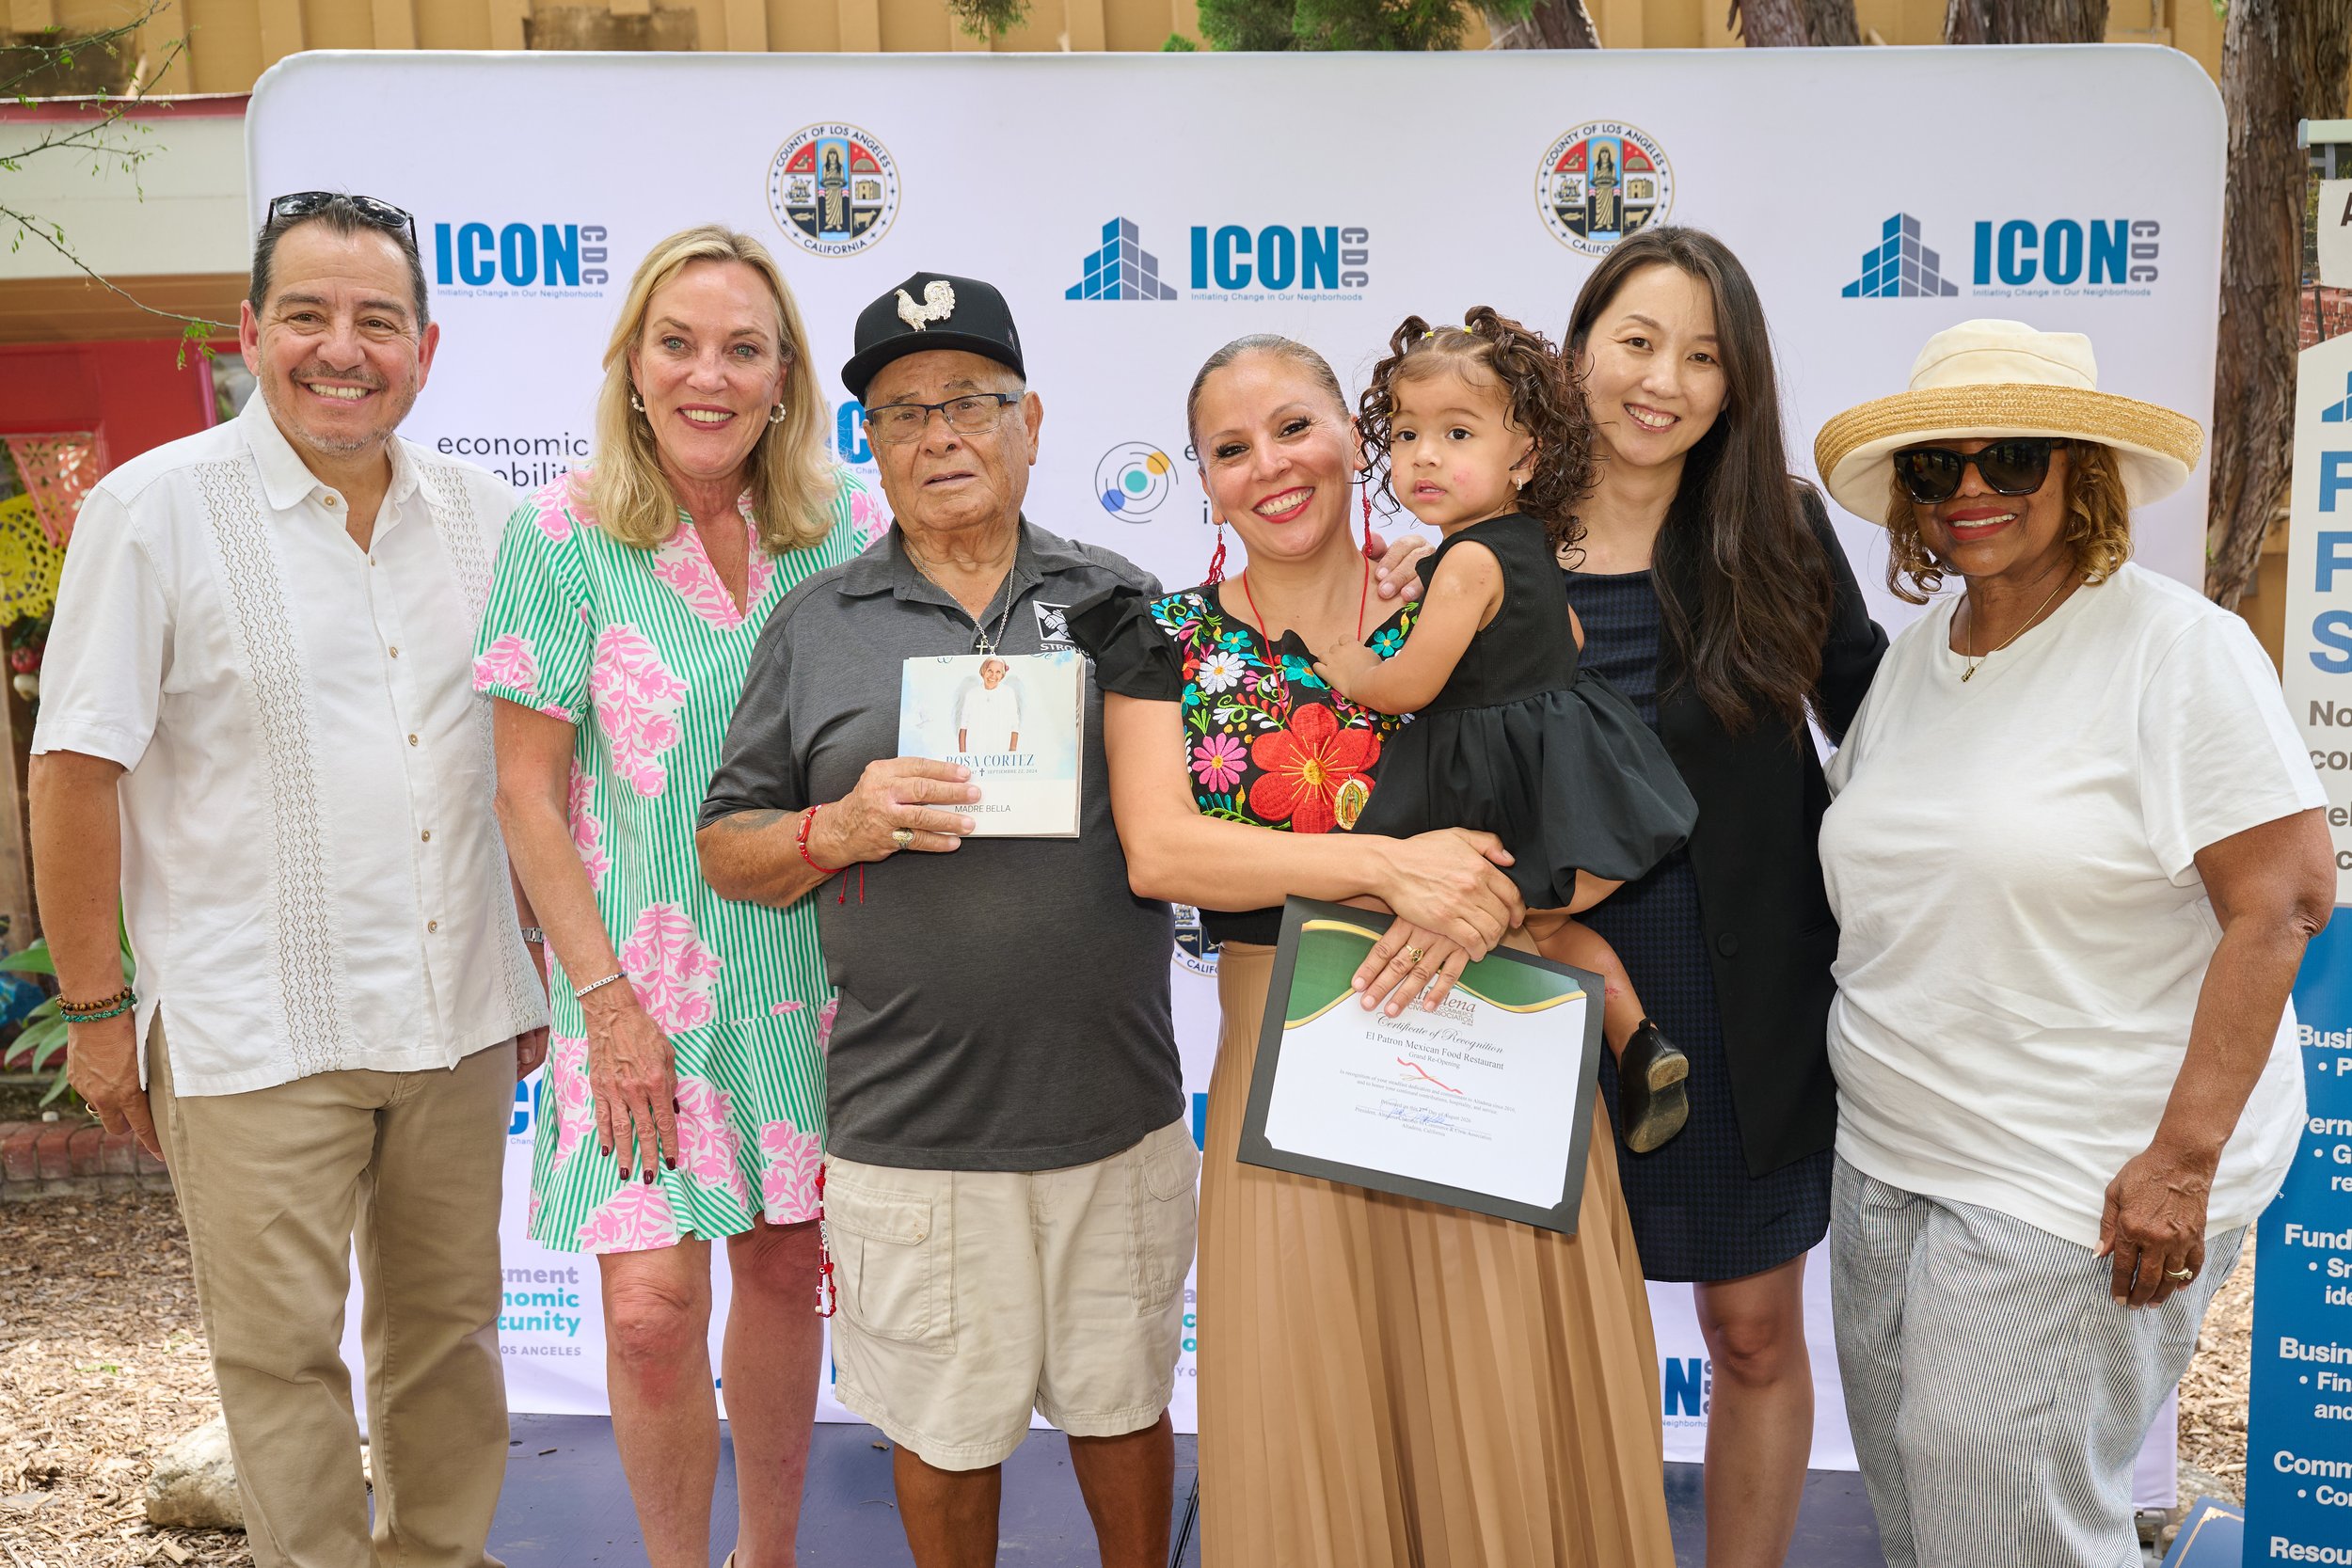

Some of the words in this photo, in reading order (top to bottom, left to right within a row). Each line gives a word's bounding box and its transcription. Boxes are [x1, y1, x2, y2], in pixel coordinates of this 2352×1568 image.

[776, 133, 807, 167] COUNTY
[811, 126, 825, 137] OF
[830, 125, 850, 136] LOS
[851, 132, 891, 167] ANGELES
[1546, 131, 1580, 166] COUNTY
[1582, 124, 1597, 135] OF
[1602, 123, 1622, 135] LOS
[1624, 129, 1665, 166] ANGELES
[435, 222, 580, 287] ICON
[580, 225, 610, 285] CDC
[803, 239, 867, 255] CALIFORNIA
[1572, 239, 1614, 254] CALIFO
[1973, 218, 2129, 286] ICON
[2129, 219, 2160, 282] CDC
[1191, 225, 1339, 291] ICON
[1341, 227, 1370, 288] CDC
[437, 289, 473, 298] Initiating
[476, 289, 509, 298] Change
[511, 289, 518, 297] in
[540, 290, 603, 299] Neighborhoods
[1191, 293, 1229, 302] Initiating
[1231, 293, 1264, 302] Change
[1297, 293, 1362, 302] Neighborhoods
[1972, 288, 2011, 297] Initiating
[2014, 288, 2050, 297] Change
[2052, 288, 2060, 296] in
[2063, 288, 2080, 296] Our
[2083, 288, 2152, 297] Neighborhoods
[437, 432, 589, 456] economic
[493, 462, 567, 486] bili
[856, 467, 881, 475] Chan
[1040, 642, 1089, 657] STRO
[2309, 700, 2352, 728] No
[983, 754, 1035, 767] CORTEZ
[2309, 750, 2352, 770] co
[954, 804, 984, 814] MADRE
[985, 804, 1011, 813] BELLA
[1186, 959, 1217, 974] CALIF
[1431, 1009, 1474, 1024] SSOCIATION
[1439, 1006, 1474, 1019] COMMERCE
[1375, 1012, 1428, 1036] Certificate
[1428, 1030, 1440, 1041] of
[1441, 1028, 1503, 1053] Recognition
[1365, 1031, 1375, 1040] El
[1376, 1034, 1404, 1047] Patron
[1406, 1039, 1439, 1054] Mexican
[1441, 1048, 1462, 1060] Food
[1464, 1053, 1504, 1070] Restaurant
[1408, 1051, 1427, 1061] Grand
[1427, 1055, 1461, 1069] Re-Opening
[510, 1137, 535, 1146] Chang
[501, 1266, 580, 1285] ment
[502, 1287, 580, 1307] nomic
[498, 1310, 581, 1338] tunity
[501, 1345, 517, 1355] OS
[520, 1346, 581, 1356] ANGELES
[2317, 1370, 2352, 1392] Fin
[1661, 1419, 1708, 1429] Neighborho
[2315, 1485, 2352, 1508] Co
